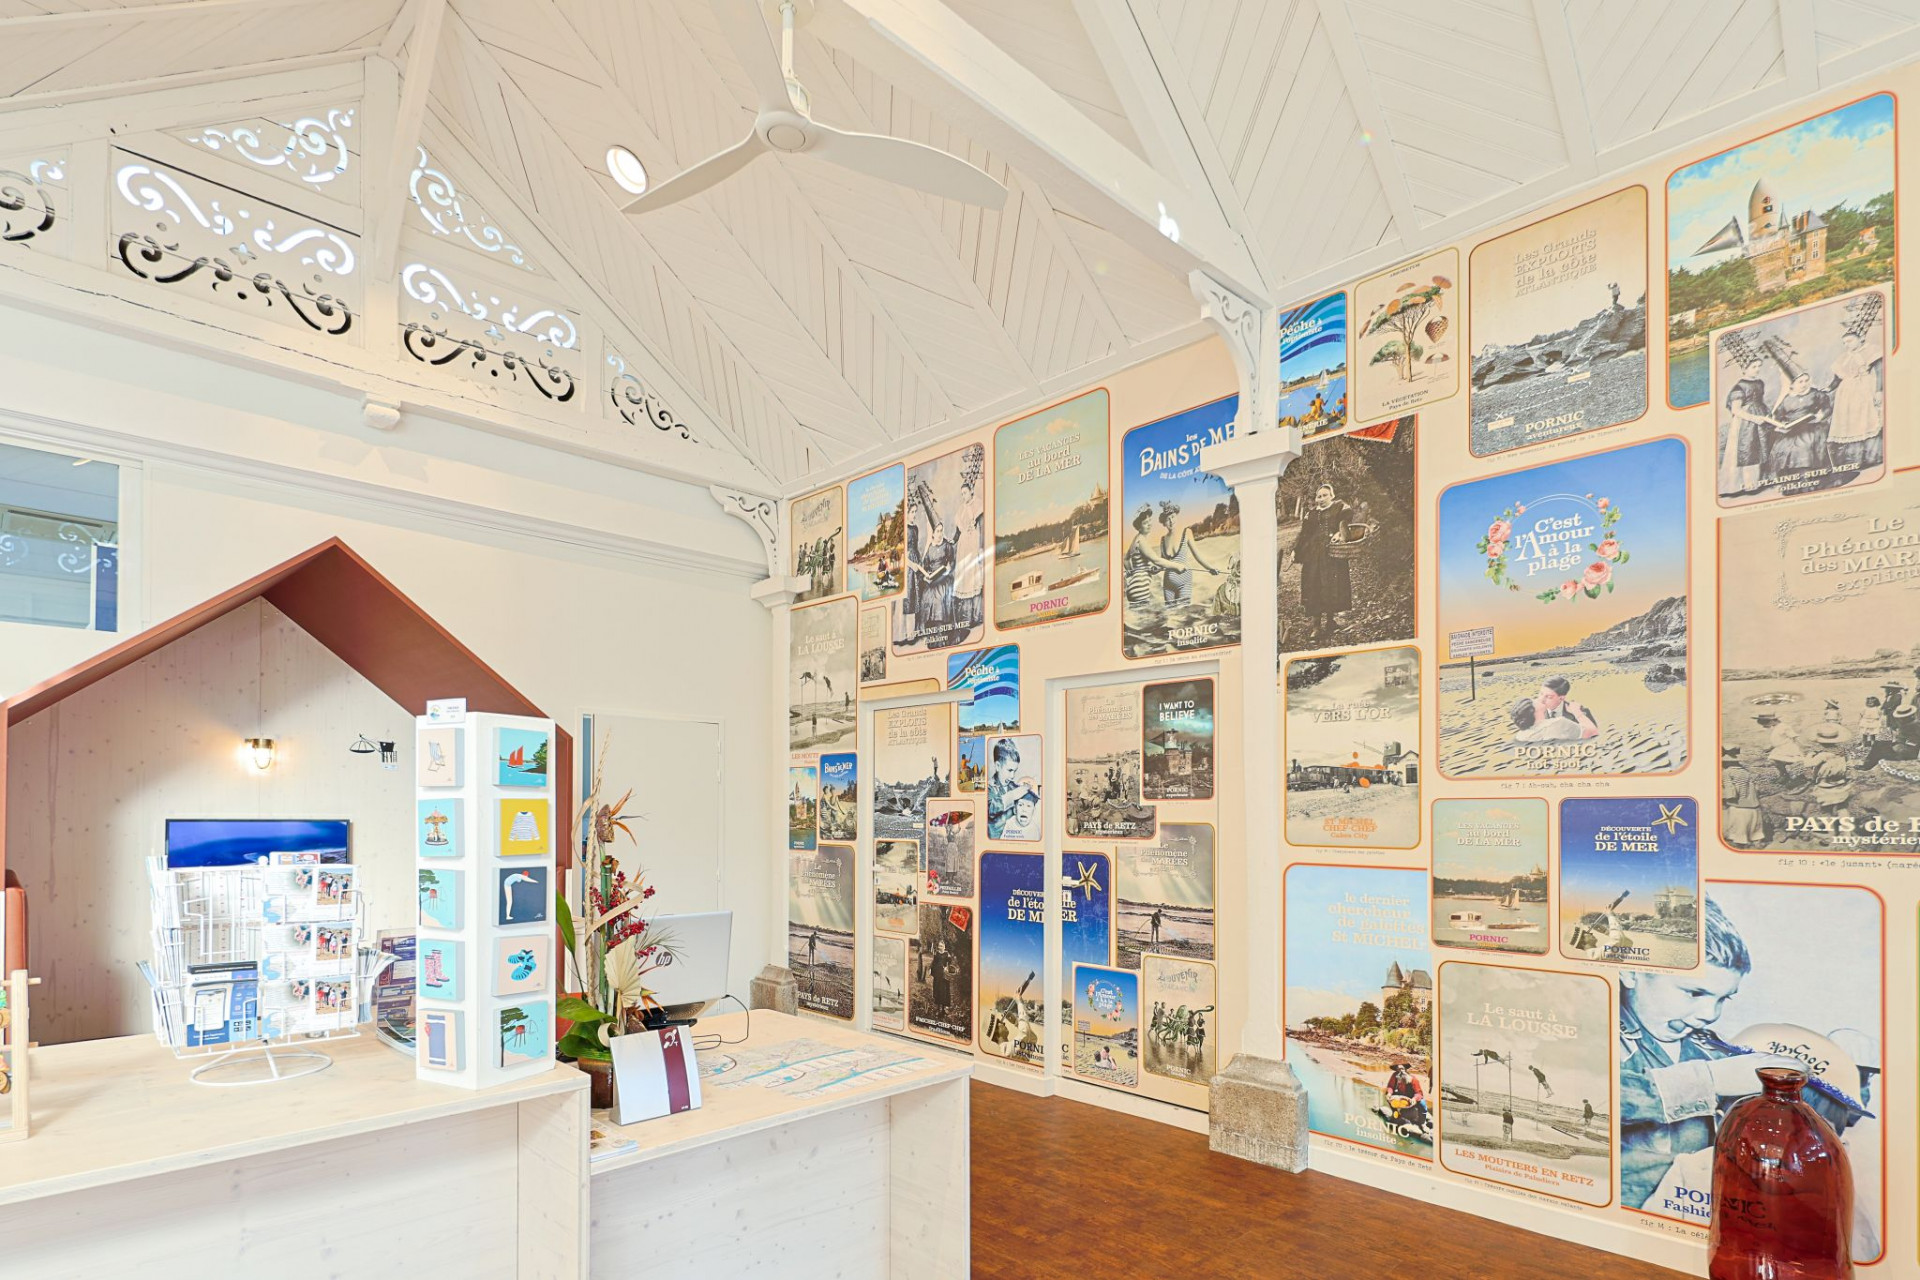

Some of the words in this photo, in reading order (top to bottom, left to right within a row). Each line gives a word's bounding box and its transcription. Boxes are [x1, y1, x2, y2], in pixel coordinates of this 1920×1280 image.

[1515, 251, 1540, 265] Les
[1543, 229, 1597, 253] Grands
[1515, 238, 1597, 277] EXPLOITS
[1515, 276, 1536, 289] de
[1540, 267, 1556, 280] la
[1560, 254, 1597, 274] côte
[1515, 264, 1597, 298] ATLANTIQUE
[1280, 319, 1316, 338] Pêche
[1525, 410, 1584, 433] PORNIC
[1186, 434, 1197, 442] les
[1020, 449, 1034, 460] LES
[1036, 433, 1080, 453] VACANCES
[1140, 445, 1189, 477] BAINS
[1208, 422, 1235, 446] ME
[1028, 459, 1041, 469] au
[1044, 445, 1070, 463] bord
[1018, 470, 1034, 484] DE
[1036, 465, 1051, 478] LA
[1054, 455, 1081, 472] MER
[1177, 470, 1193, 478] CÔTE
[1777, 480, 1820, 496] folklore
[1534, 514, 1582, 533] C'est
[1868, 517, 1905, 535] Le
[1514, 526, 1595, 562] l'Amour
[1548, 544, 1558, 556] à
[1564, 542, 1582, 555] la
[1528, 555, 1582, 577] plage
[1801, 561, 1838, 574] des
[1030, 597, 1068, 612] PORNIC
[805, 635, 814, 643] Le
[815, 634, 830, 642] saut
[1168, 623, 1218, 639] PORNIC
[798, 646, 809, 655] LA
[812, 638, 845, 652] LOUSSE
[1177, 637, 1208, 646] insolite
[965, 664, 994, 677] Pêche
[1163, 701, 1182, 710] WANT
[1184, 700, 1195, 708] TO
[1159, 710, 1195, 721] BELIEVE
[1312, 710, 1351, 723] VERS
[1354, 707, 1392, 721] L'OR
[1514, 744, 1599, 760] PORNIC
[1526, 759, 1550, 770] hot
[1553, 759, 1583, 771] spot
[1601, 825, 1652, 833] DÉCOUVERTE
[1785, 816, 1855, 832] PAYS
[1864, 816, 1899, 832] de
[1467, 830, 1481, 838] au
[1483, 829, 1510, 837] bord
[1595, 832, 1611, 841] de
[1613, 831, 1658, 842] l'étoile
[1457, 837, 1474, 846] DE
[1476, 838, 1492, 846] LA
[1494, 837, 1521, 847] MER
[1595, 841, 1619, 851] DE
[1621, 842, 1659, 853] MER
[1008, 897, 1020, 907] de
[1345, 892, 1355, 904] le
[1359, 893, 1410, 907] dernier
[1008, 908, 1026, 921] DE
[1328, 904, 1411, 918] chercheur
[1338, 917, 1355, 928] de
[1332, 931, 1348, 943] St
[1353, 932, 1423, 950] MICHEL
[1469, 933, 1509, 944] PORNIC
[1603, 945, 1650, 956] PORNIC
[798, 993, 812, 1001] PAYS
[813, 995, 820, 1003] de
[822, 997, 839, 1007] RETZ
[1485, 1003, 1504, 1015] Le
[1507, 1007, 1543, 1021] saut
[1548, 1010, 1557, 1022] à
[1467, 1012, 1493, 1027] LA
[1499, 1018, 1578, 1039] LOUSSE
[1344, 1112, 1410, 1139] PORNIC
[1355, 1127, 1398, 1146] insolite
[1455, 1148, 1476, 1161] LES
[1478, 1153, 1538, 1174] MOUTIERS
[1541, 1166, 1558, 1178] EN
[1561, 1170, 1594, 1187] RETZ
[1514, 1170, 1523, 1178] de
[1675, 1226, 1687, 1235] La
